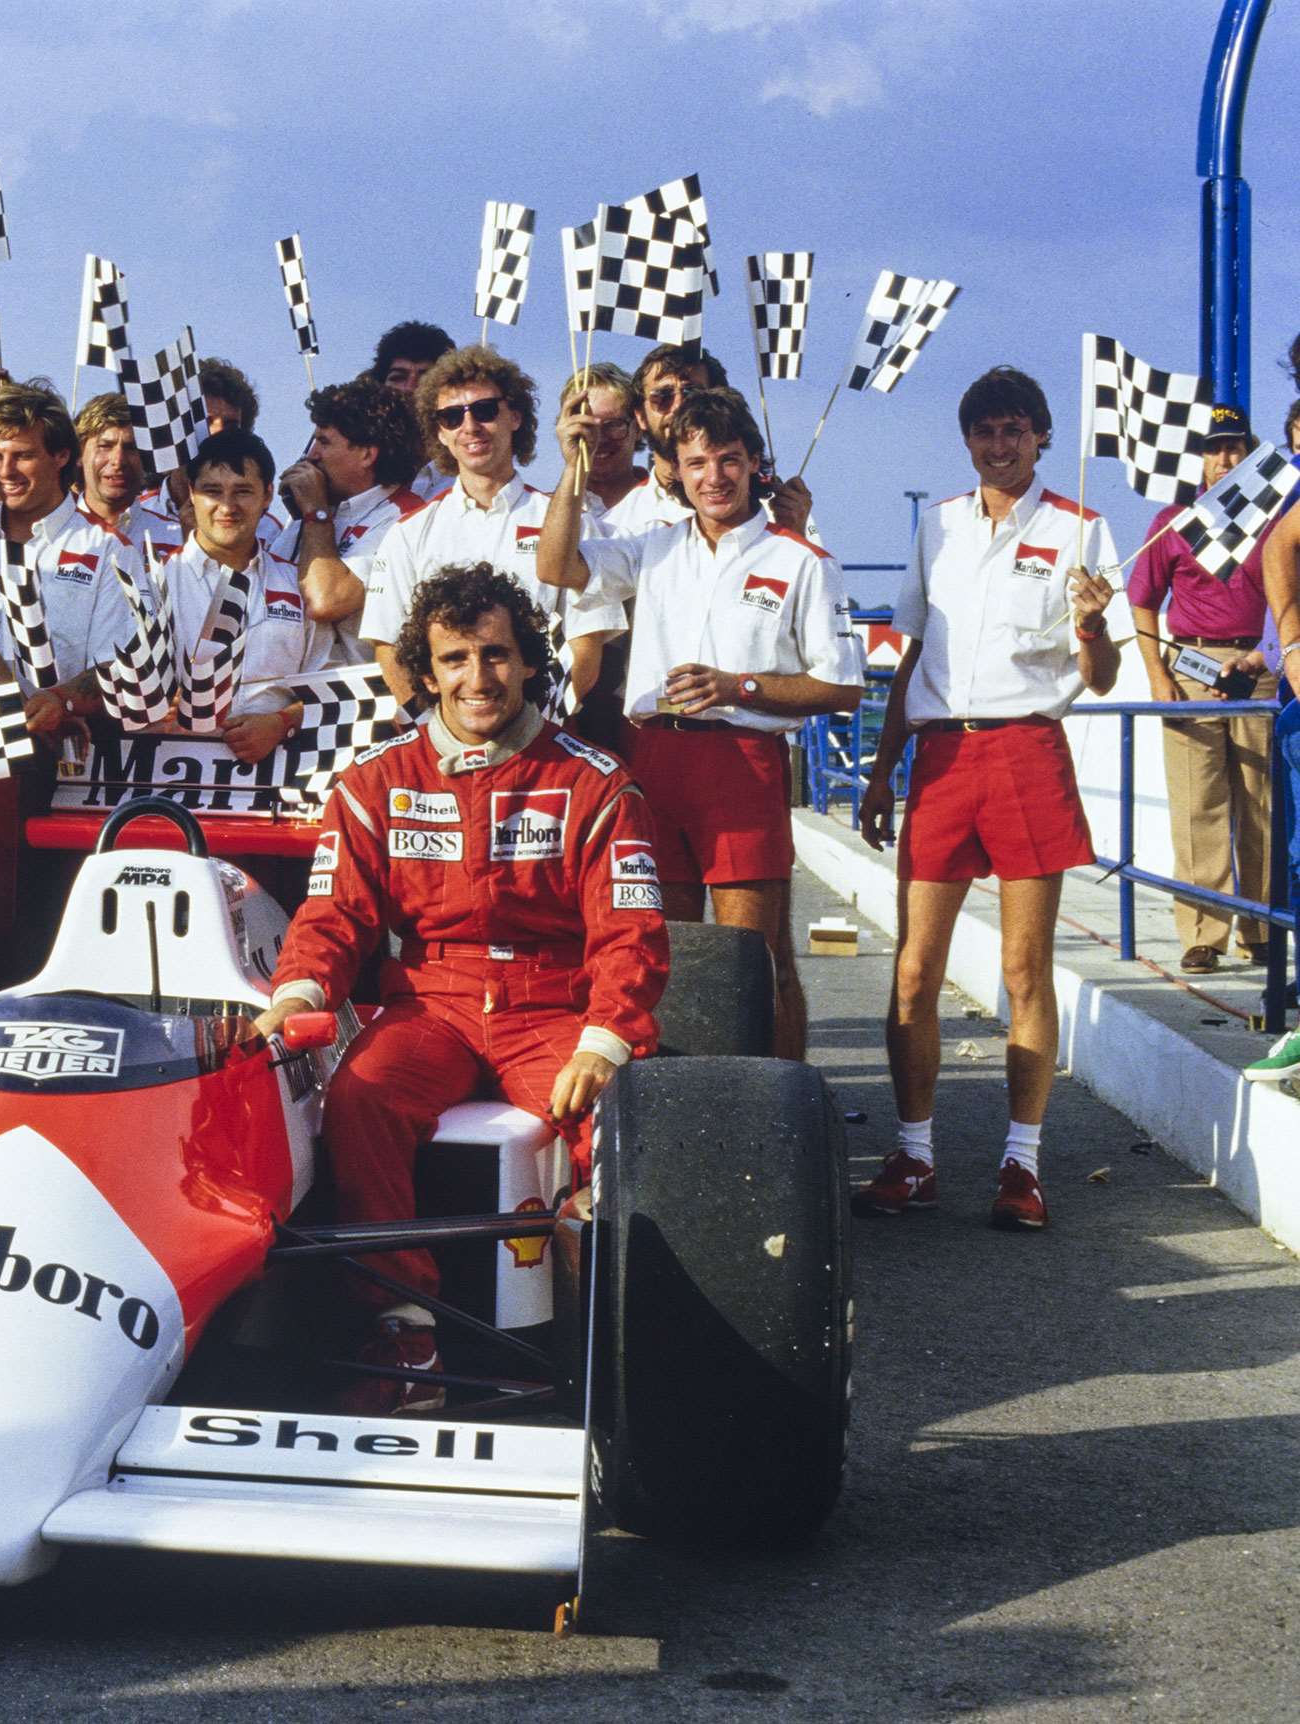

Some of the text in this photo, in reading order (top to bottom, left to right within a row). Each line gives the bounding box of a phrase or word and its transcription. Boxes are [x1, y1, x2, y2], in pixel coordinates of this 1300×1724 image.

[516, 540, 538, 551] Marl
[57, 566, 93, 582] Marlboro
[1014, 560, 1052, 577] Marlboro
[742, 590, 781, 610] Marlboro
[266, 605, 301, 619] Marlboro
[82, 737, 300, 811] Marl
[415, 803, 458, 816] Shell
[493, 817, 562, 845] Marlboro
[393, 831, 458, 854] BOSS
[619, 858, 656, 875] Marlbo
[114, 872, 172, 887] MP4
[309, 880, 329, 890] ell
[3, 1027, 105, 1052] TAG
[183, 1414, 496, 1462] Shell
